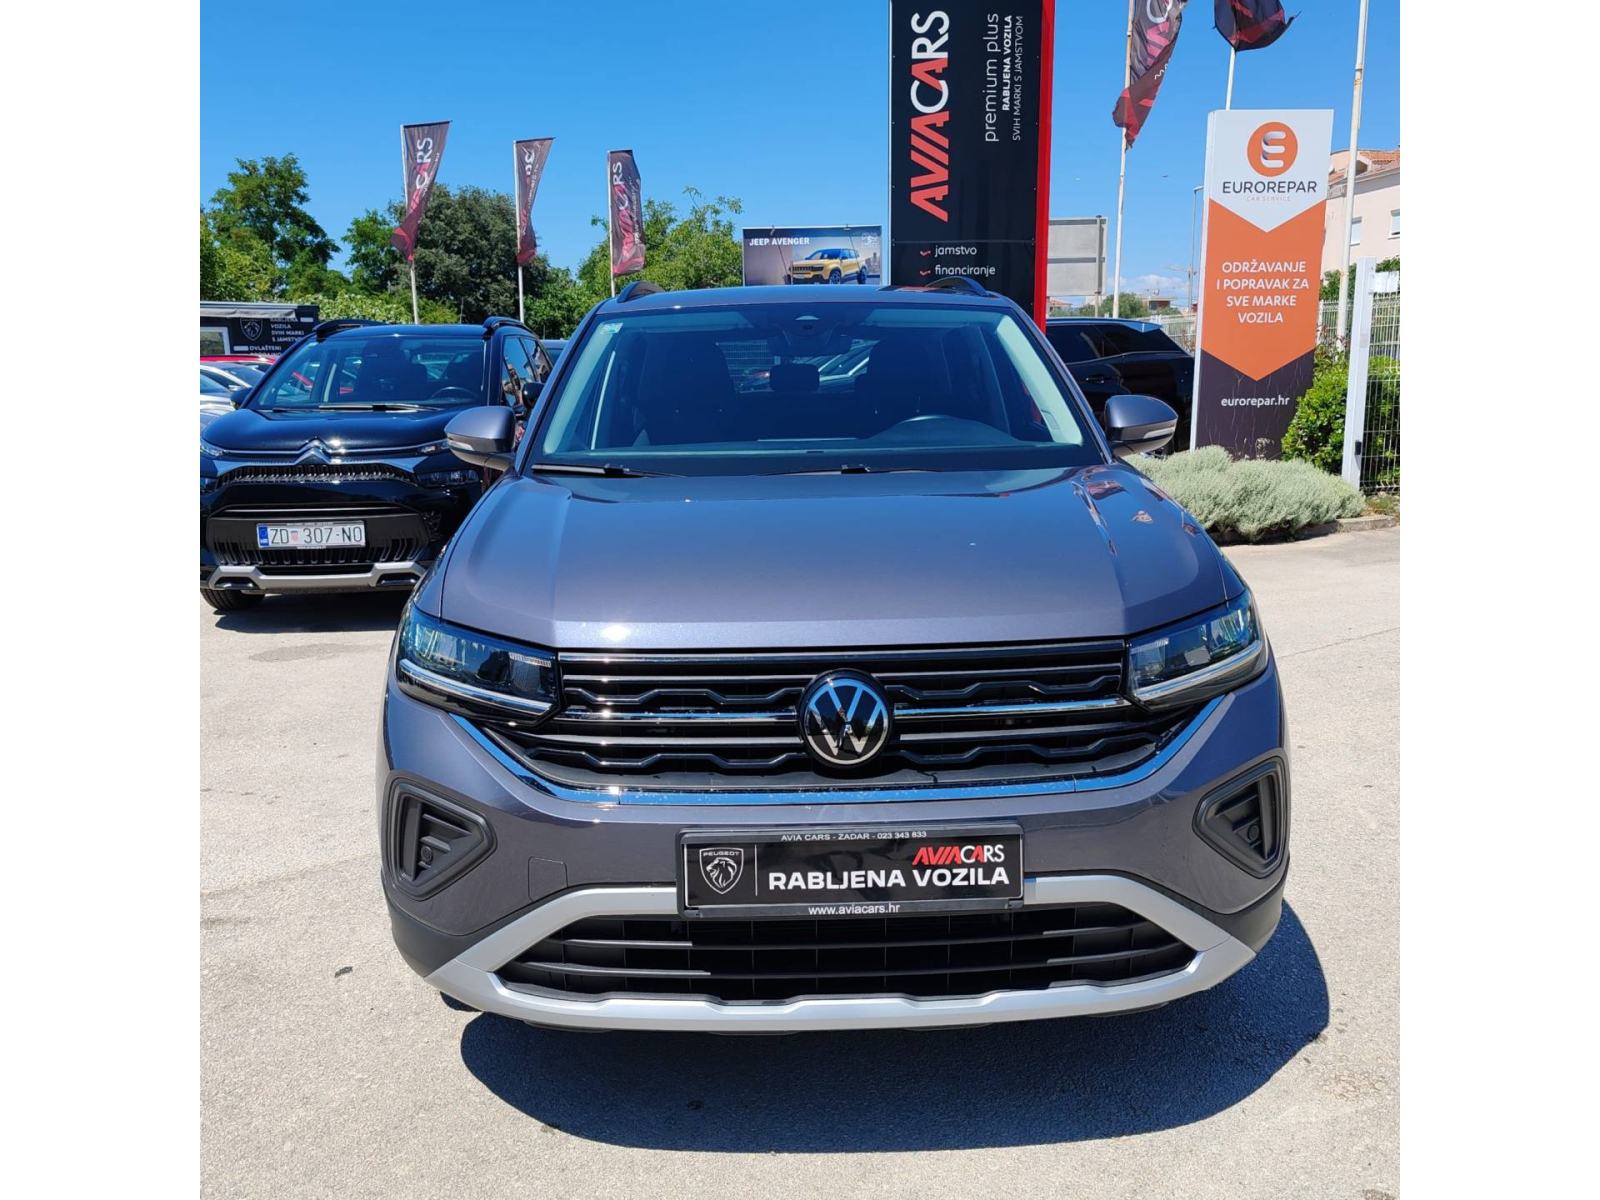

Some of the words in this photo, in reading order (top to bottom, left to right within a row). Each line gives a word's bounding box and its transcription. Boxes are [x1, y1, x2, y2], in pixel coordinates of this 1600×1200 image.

[982, 13, 1001, 52] plus
[1003, 15, 1013, 55] VOZILA
[1014, 16, 1024, 73] JAMSTVOM
[1002, 57, 1012, 111] RABLJENA
[982, 59, 999, 142] premium
[1013, 85, 1022, 115] MARKI
[910, 10, 950, 222] AVIACARS
[1012, 118, 1021, 141] SVIH
[1222, 181, 1318, 194] EUROREPAR
[749, 237, 770, 246] JEEP
[771, 237, 810, 245] AVENGER
[934, 245, 977, 258] jamstvo
[934, 264, 996, 277] financiranje
[1222, 258, 1306, 273] ODRŽAVANJE
[1216, 279, 1220, 290] I
[1223, 279, 1290, 290] POPRAVAK
[1292, 278, 1310, 289] ZA
[1226, 295, 1249, 307] SVE
[1251, 295, 1297, 306] MARKE
[1237, 312, 1284, 323] VOZILA
[1220, 395, 1290, 408] eurorepar.hr
[270, 528, 289, 544] ZD
[804, 833, 830, 841] CARS
[912, 844, 1005, 865] AVIACARS
[768, 870, 906, 890] RABLJENA
[912, 867, 1010, 887] VOZILA
[808, 902, 901, 915] www.aviacars.hr
